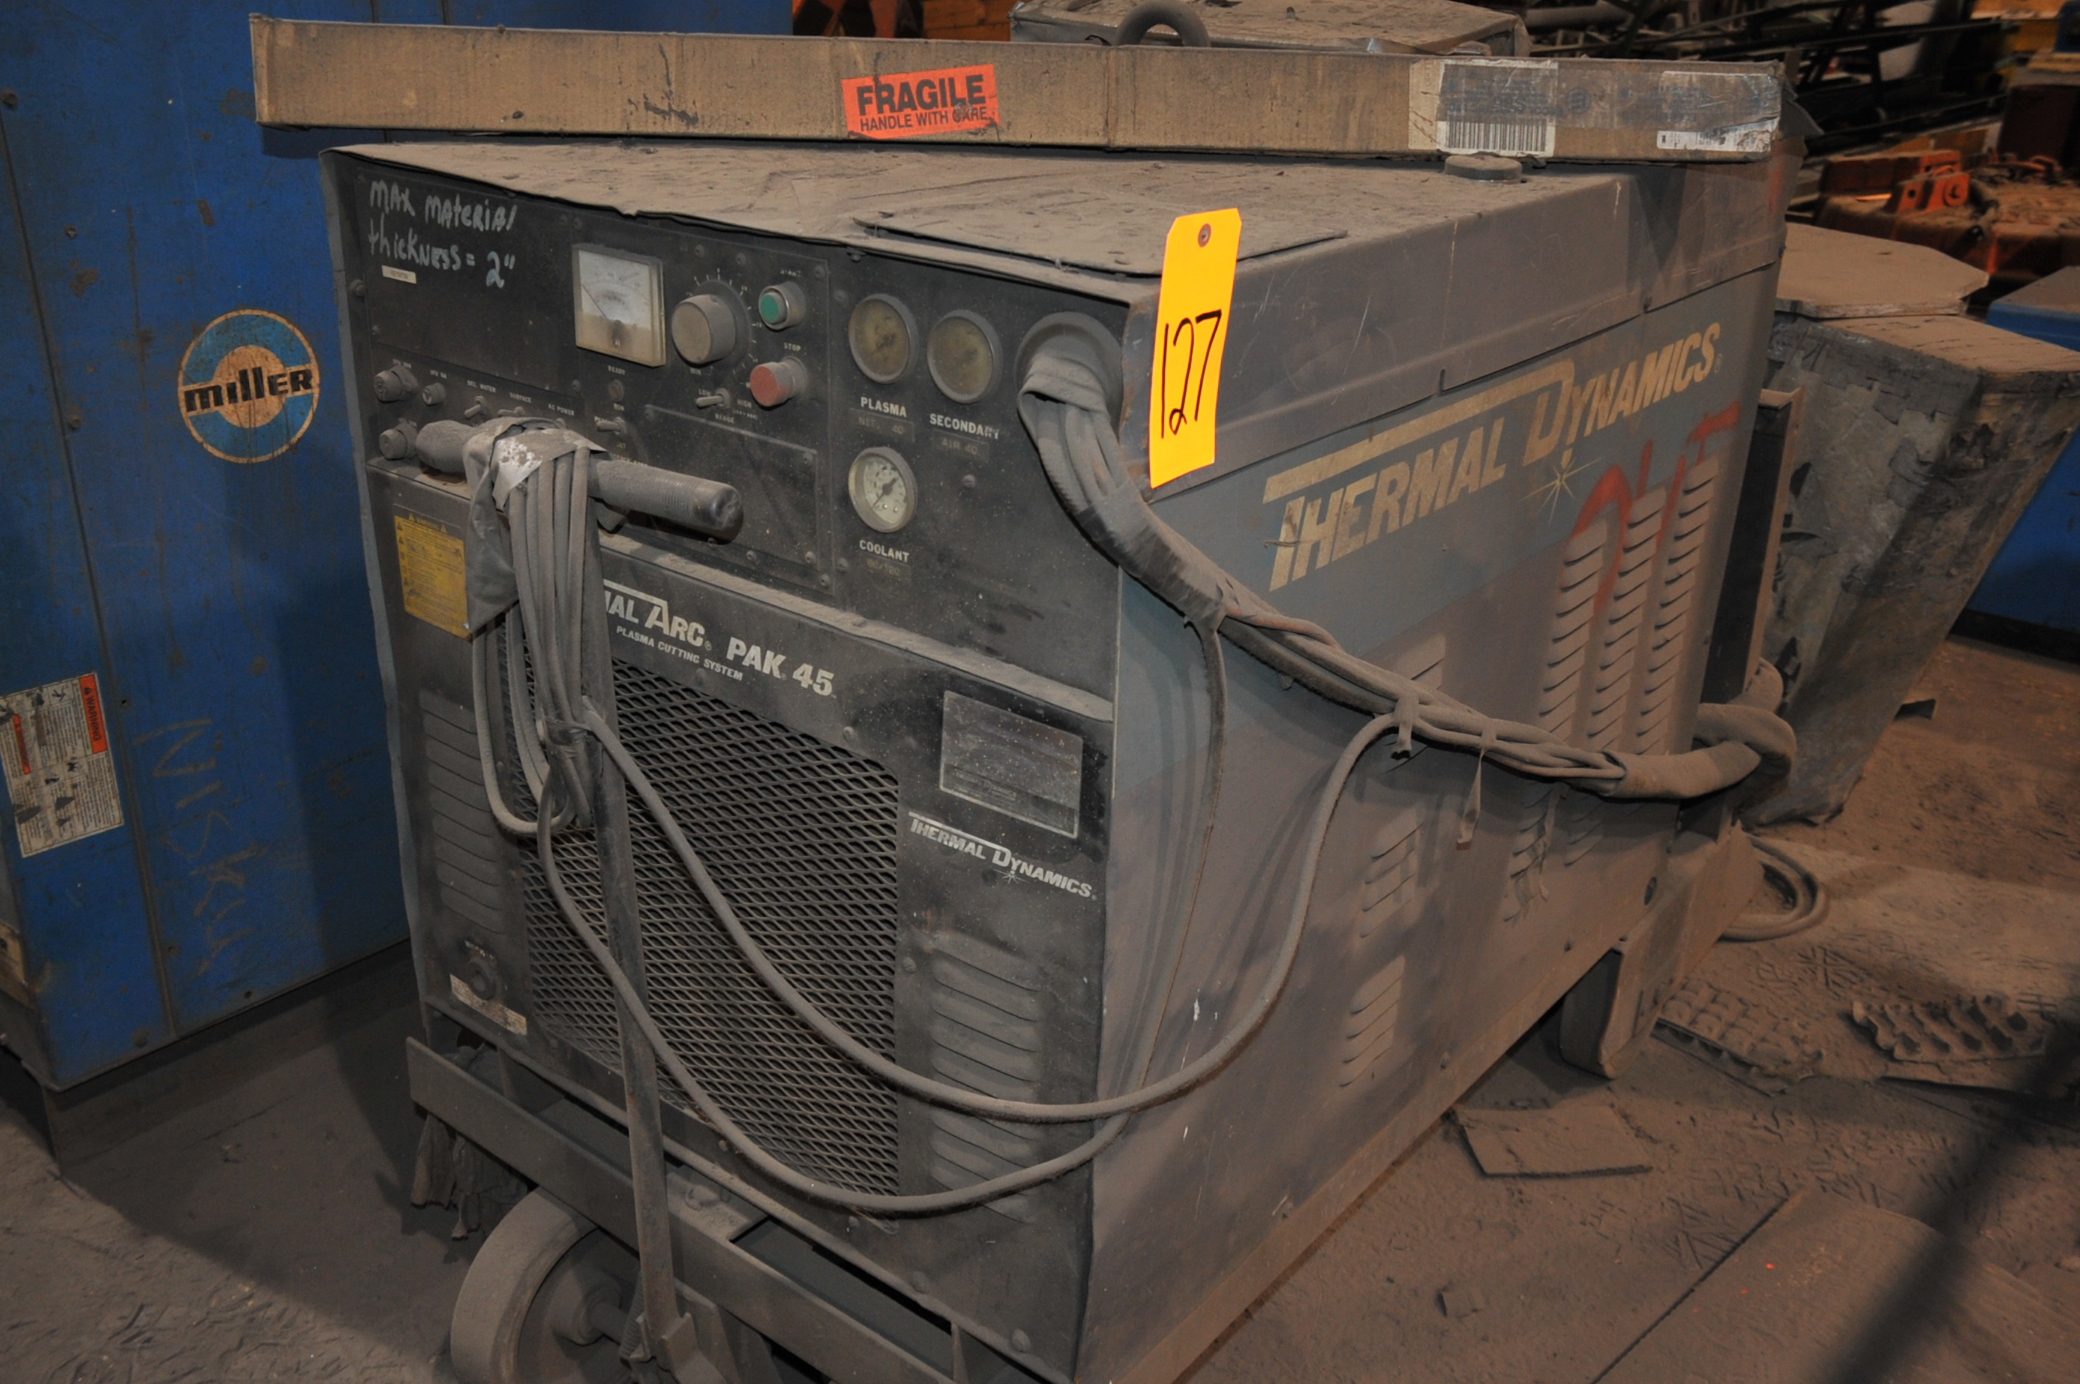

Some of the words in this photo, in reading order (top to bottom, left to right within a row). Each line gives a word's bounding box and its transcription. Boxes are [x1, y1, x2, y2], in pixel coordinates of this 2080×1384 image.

[857, 74, 986, 116] FRAGILE
[860, 113, 912, 132] HANDLE
[915, 110, 949, 126] WITH
[952, 106, 987, 123] CARE
[783, 342, 802, 353] STOP
[1160, 309, 1222, 439] 127
[547, 402, 556, 411] AC
[556, 405, 575, 417] POWER
[860, 396, 907, 418] PLASMA
[929, 413, 1000, 440] SECONDARY
[1263, 415, 1506, 592] THERMAL
[1521, 322, 1721, 467] DYNAMICS
[859, 539, 910, 563] COOLANT
[616, 625, 654, 648] PLASMA
[657, 641, 700, 664] CUTTING
[703, 658, 743, 681] SYSTEM
[726, 637, 787, 679] PAK
[792, 663, 835, 696] 45
[86, 700, 103, 742] WARNING
[908, 811, 986, 860] THERMAL
[992, 849, 1094, 898] DYNAMICS
